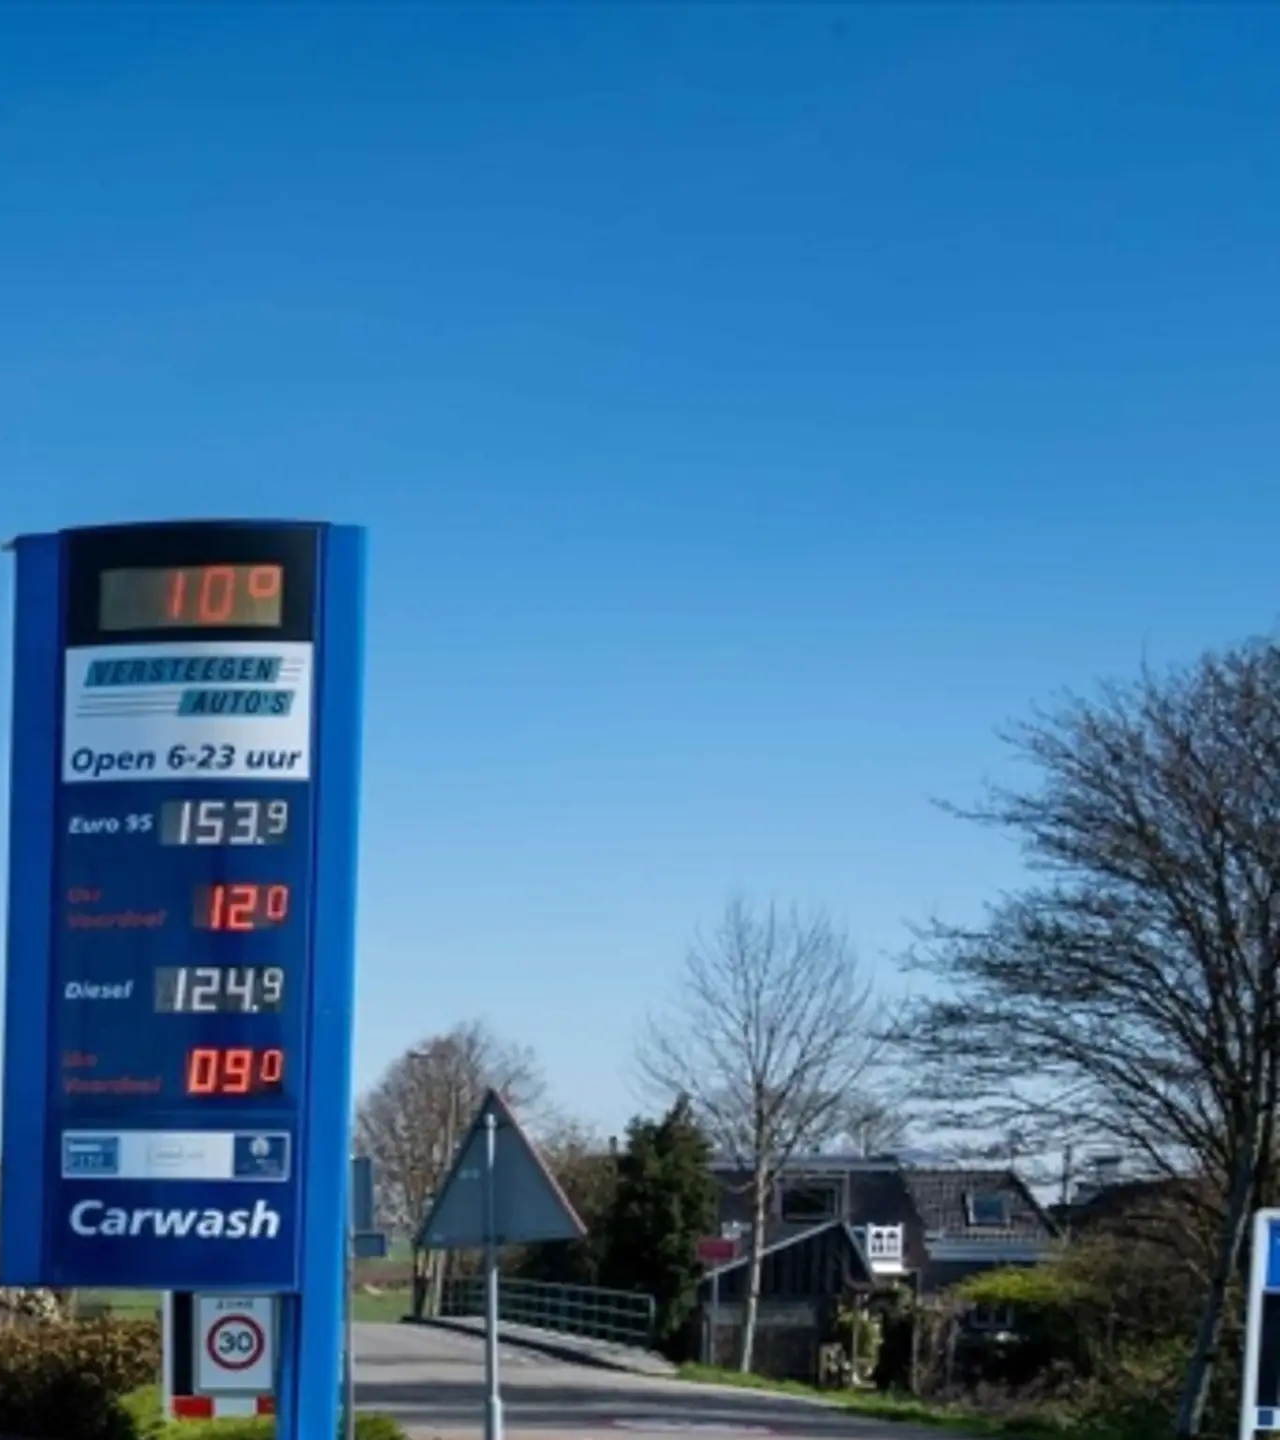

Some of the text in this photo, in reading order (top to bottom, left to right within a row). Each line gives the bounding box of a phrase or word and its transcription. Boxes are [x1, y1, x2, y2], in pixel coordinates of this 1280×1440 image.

[91, 658, 276, 684] VERSTEEGEN
[190, 690, 289, 715] AUTO'S
[70, 745, 302, 776] Open 6-23 uur
[68, 817, 119, 834] Euro
[65, 980, 134, 1000] Diesel
[69, 1200, 281, 1239] Carwash
[219, 1331, 254, 1354] 30
